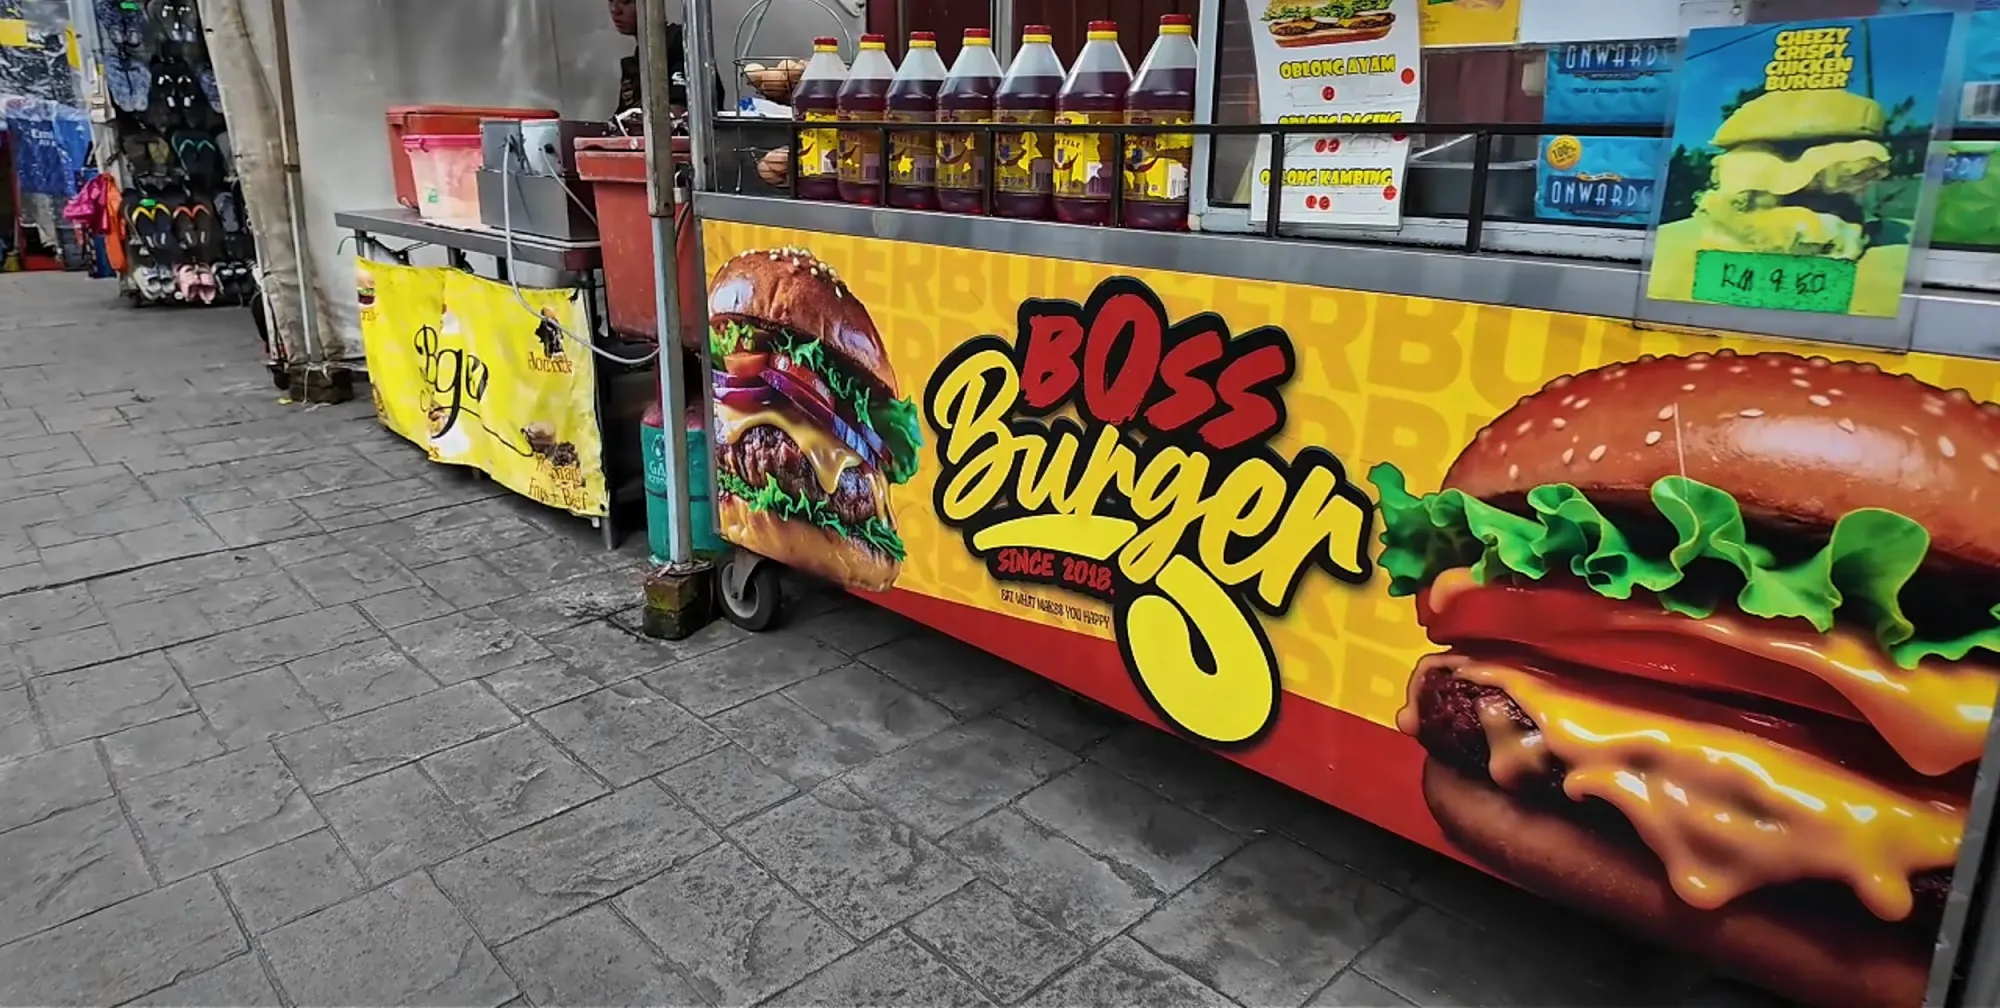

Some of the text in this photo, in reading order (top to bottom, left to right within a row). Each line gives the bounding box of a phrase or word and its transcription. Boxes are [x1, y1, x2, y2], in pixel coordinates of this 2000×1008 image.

[1776, 27, 1853, 46] CHEEZY
[1774, 43, 1849, 60] CRISPY
[1280, 55, 1396, 78] OBLONG AYAM
[1765, 57, 1854, 75] CHICKEN
[1764, 73, 1849, 90] BURGER
[1260, 168, 1393, 186] OLONG KAMBING
[1551, 181, 1649, 207] ONWARDS
[1020, 293, 1286, 449] BOSS
[933, 350, 1364, 608] Burger
[997, 547, 1056, 577] SINCE
[1037, 595, 1065, 617] MAKES
[1065, 604, 1082, 622] YOU
[1084, 609, 1111, 629] HAPPY
